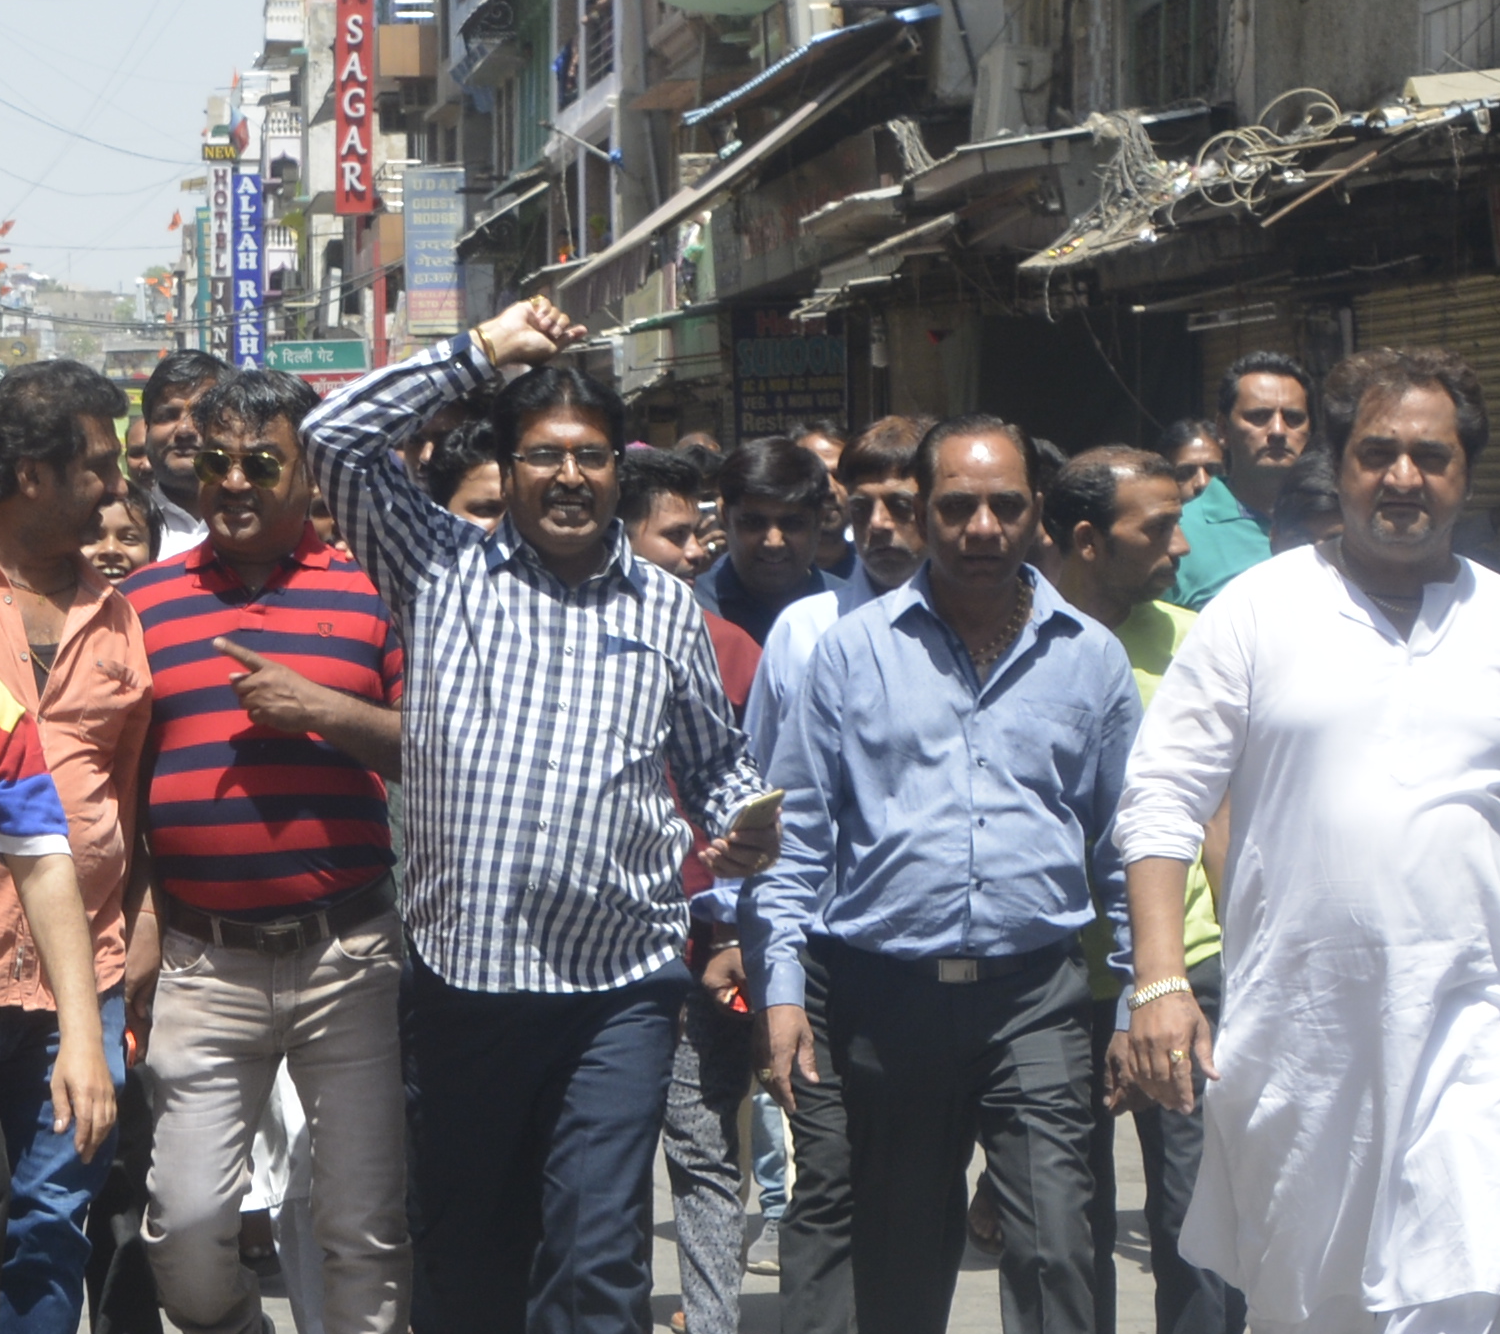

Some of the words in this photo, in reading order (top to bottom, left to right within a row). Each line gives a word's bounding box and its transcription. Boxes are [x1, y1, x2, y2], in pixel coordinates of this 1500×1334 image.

[340, 14, 369, 193] SAGAR
[204, 144, 236, 159] NEW
[214, 169, 229, 276] HOTEL
[237, 177, 259, 272] ALLAH
[412, 212, 460, 225] HOUSE
[282, 347, 313, 364] दिल्ली
[318, 347, 334, 363] गेट
[737, 336, 845, 377] SUKOON
